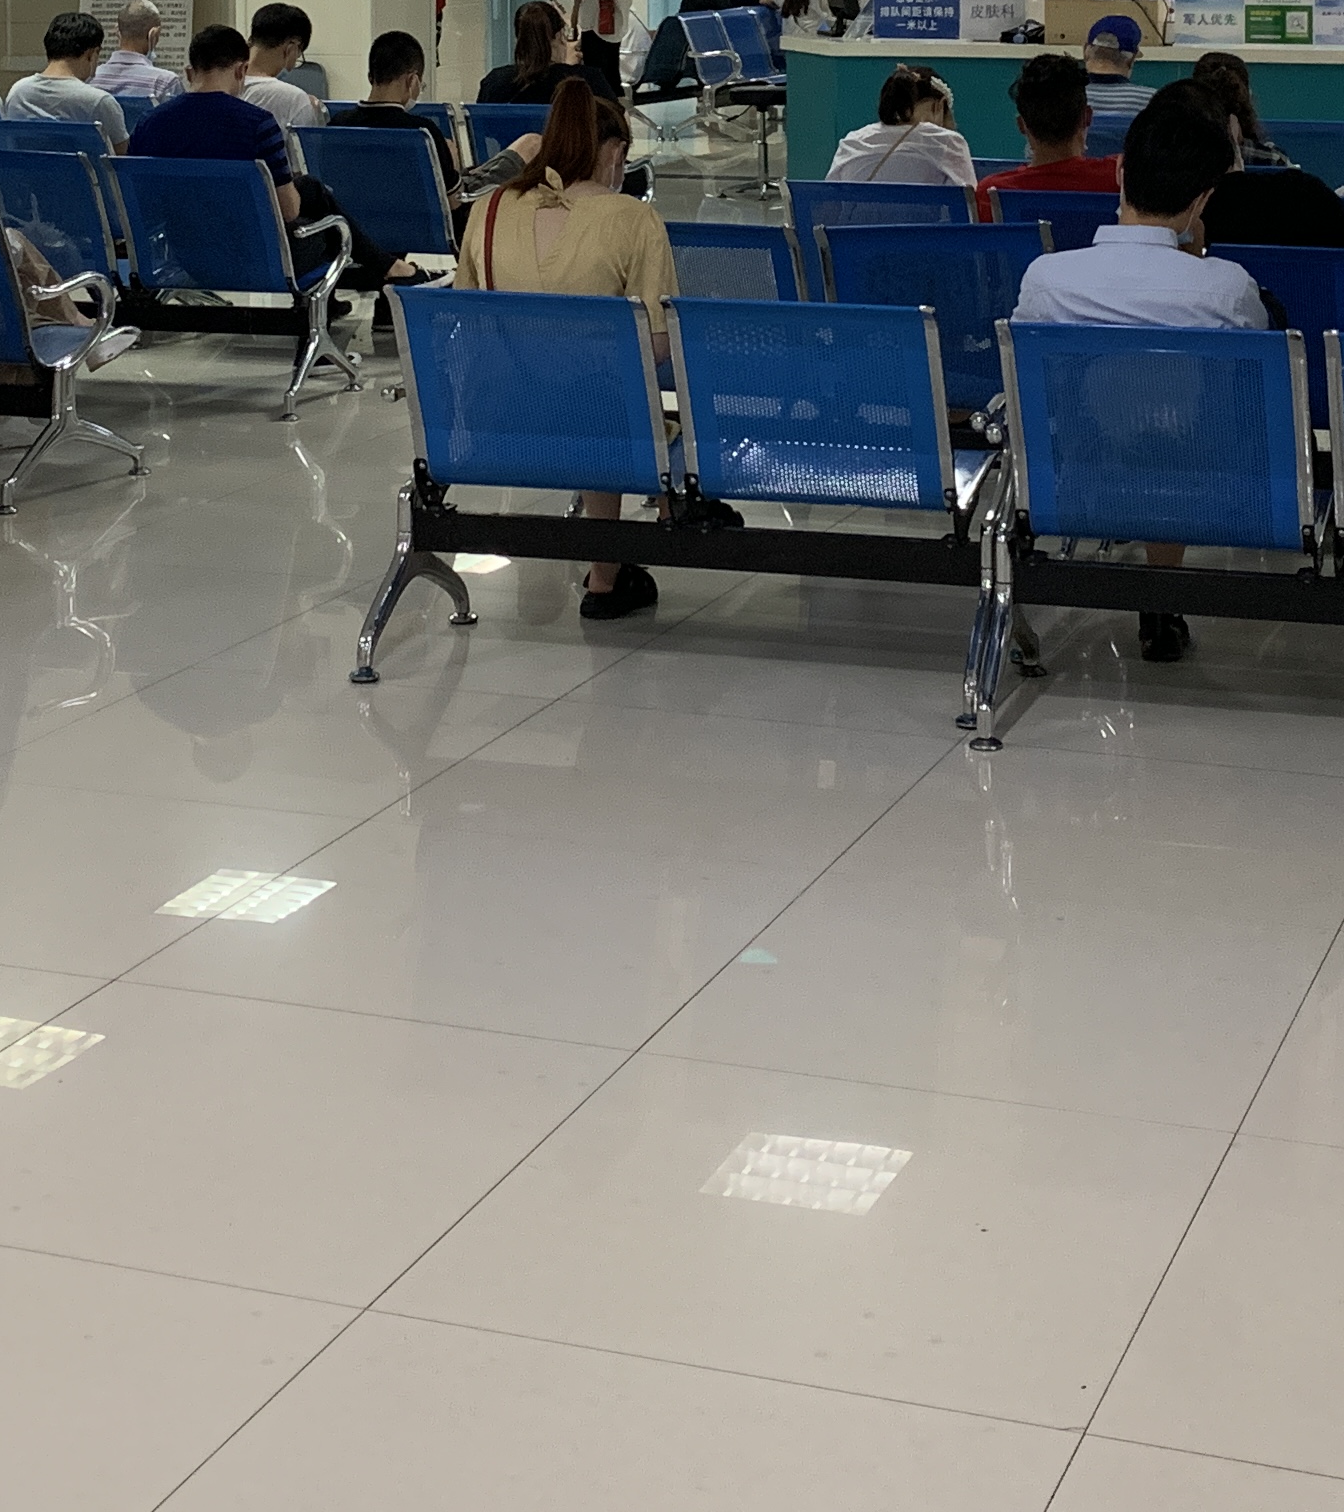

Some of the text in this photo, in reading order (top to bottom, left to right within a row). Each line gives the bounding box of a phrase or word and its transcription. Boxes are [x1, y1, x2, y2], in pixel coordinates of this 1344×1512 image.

[880, 6, 955, 18] 排队间距请保持
[970, 4, 1015, 19] 皮肤科
[896, 19, 938, 31] 一米以上
[1183, 13, 1237, 26] 军人优先
